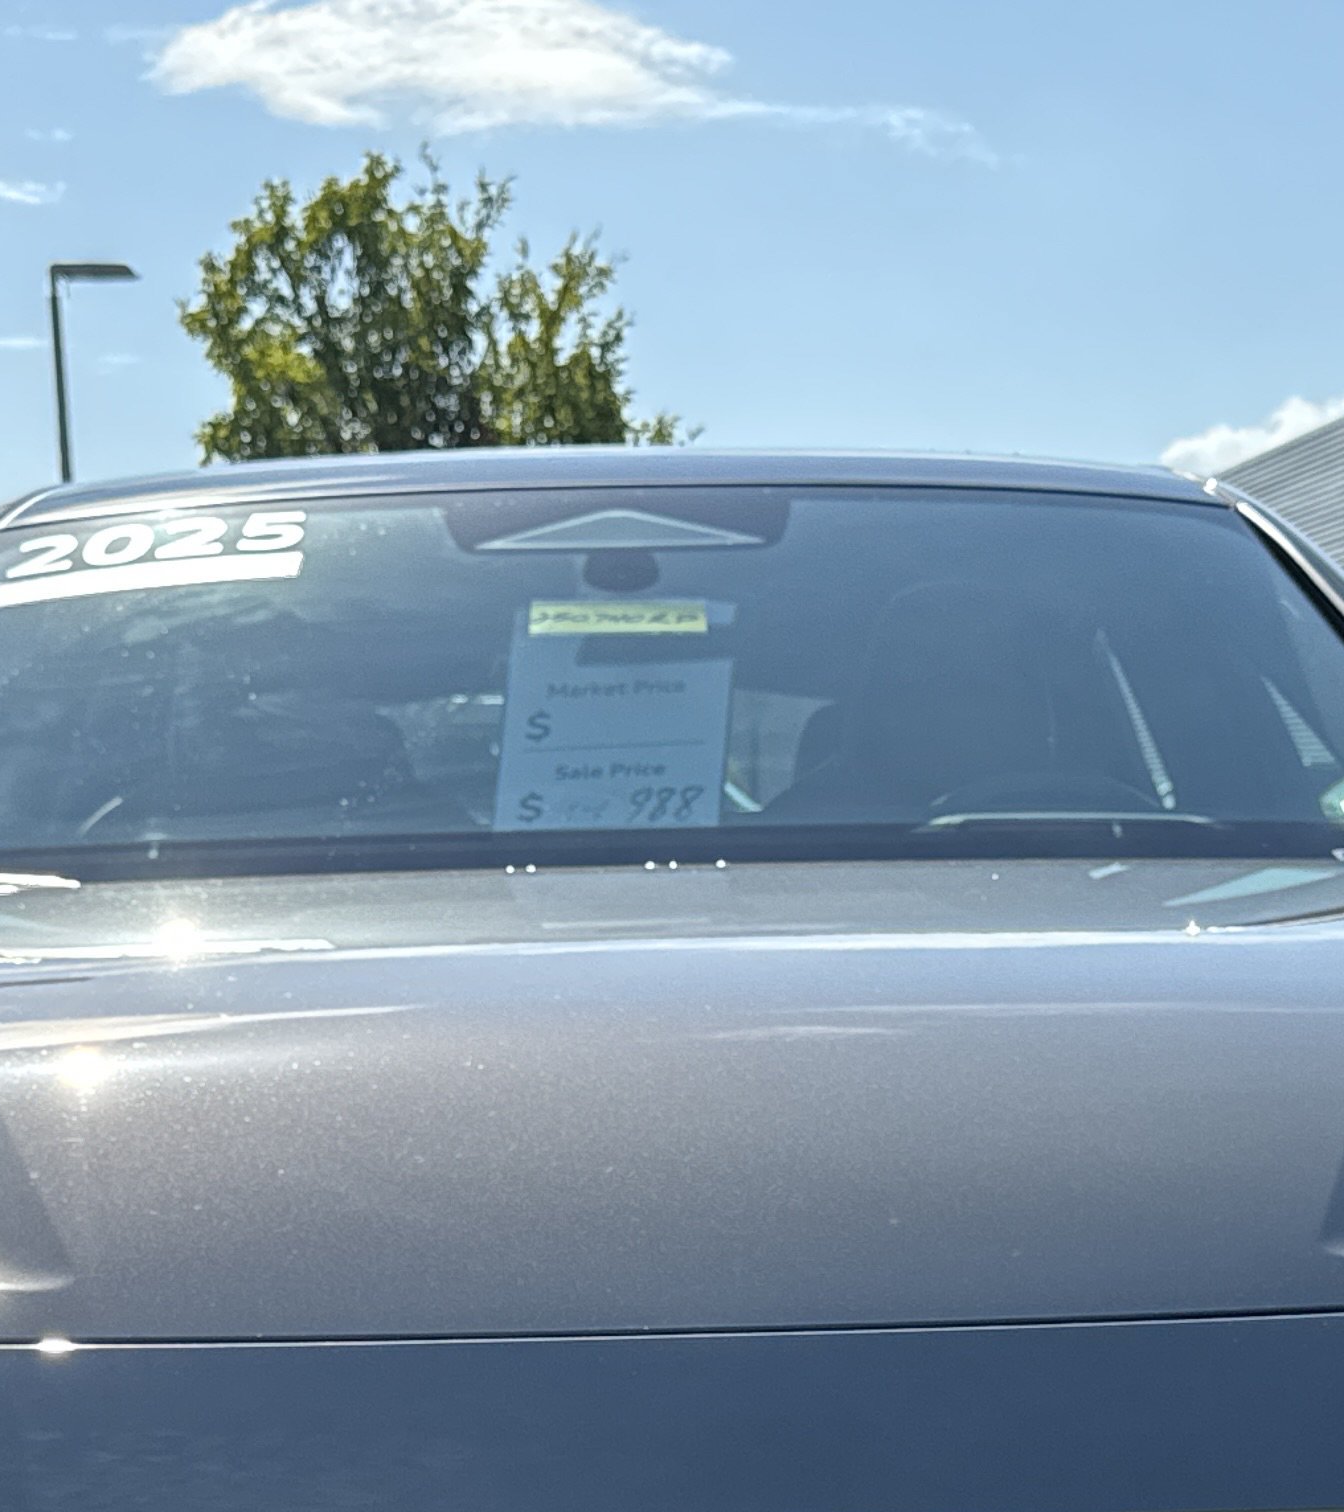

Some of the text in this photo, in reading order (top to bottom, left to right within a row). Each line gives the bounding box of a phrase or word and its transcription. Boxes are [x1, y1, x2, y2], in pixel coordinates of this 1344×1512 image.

[6, 512, 306, 579] 2025
[547, 680, 686, 698] Market Price
[525, 708, 551, 741] $
[557, 762, 666, 780] Sale Price
[517, 791, 543, 822] $
